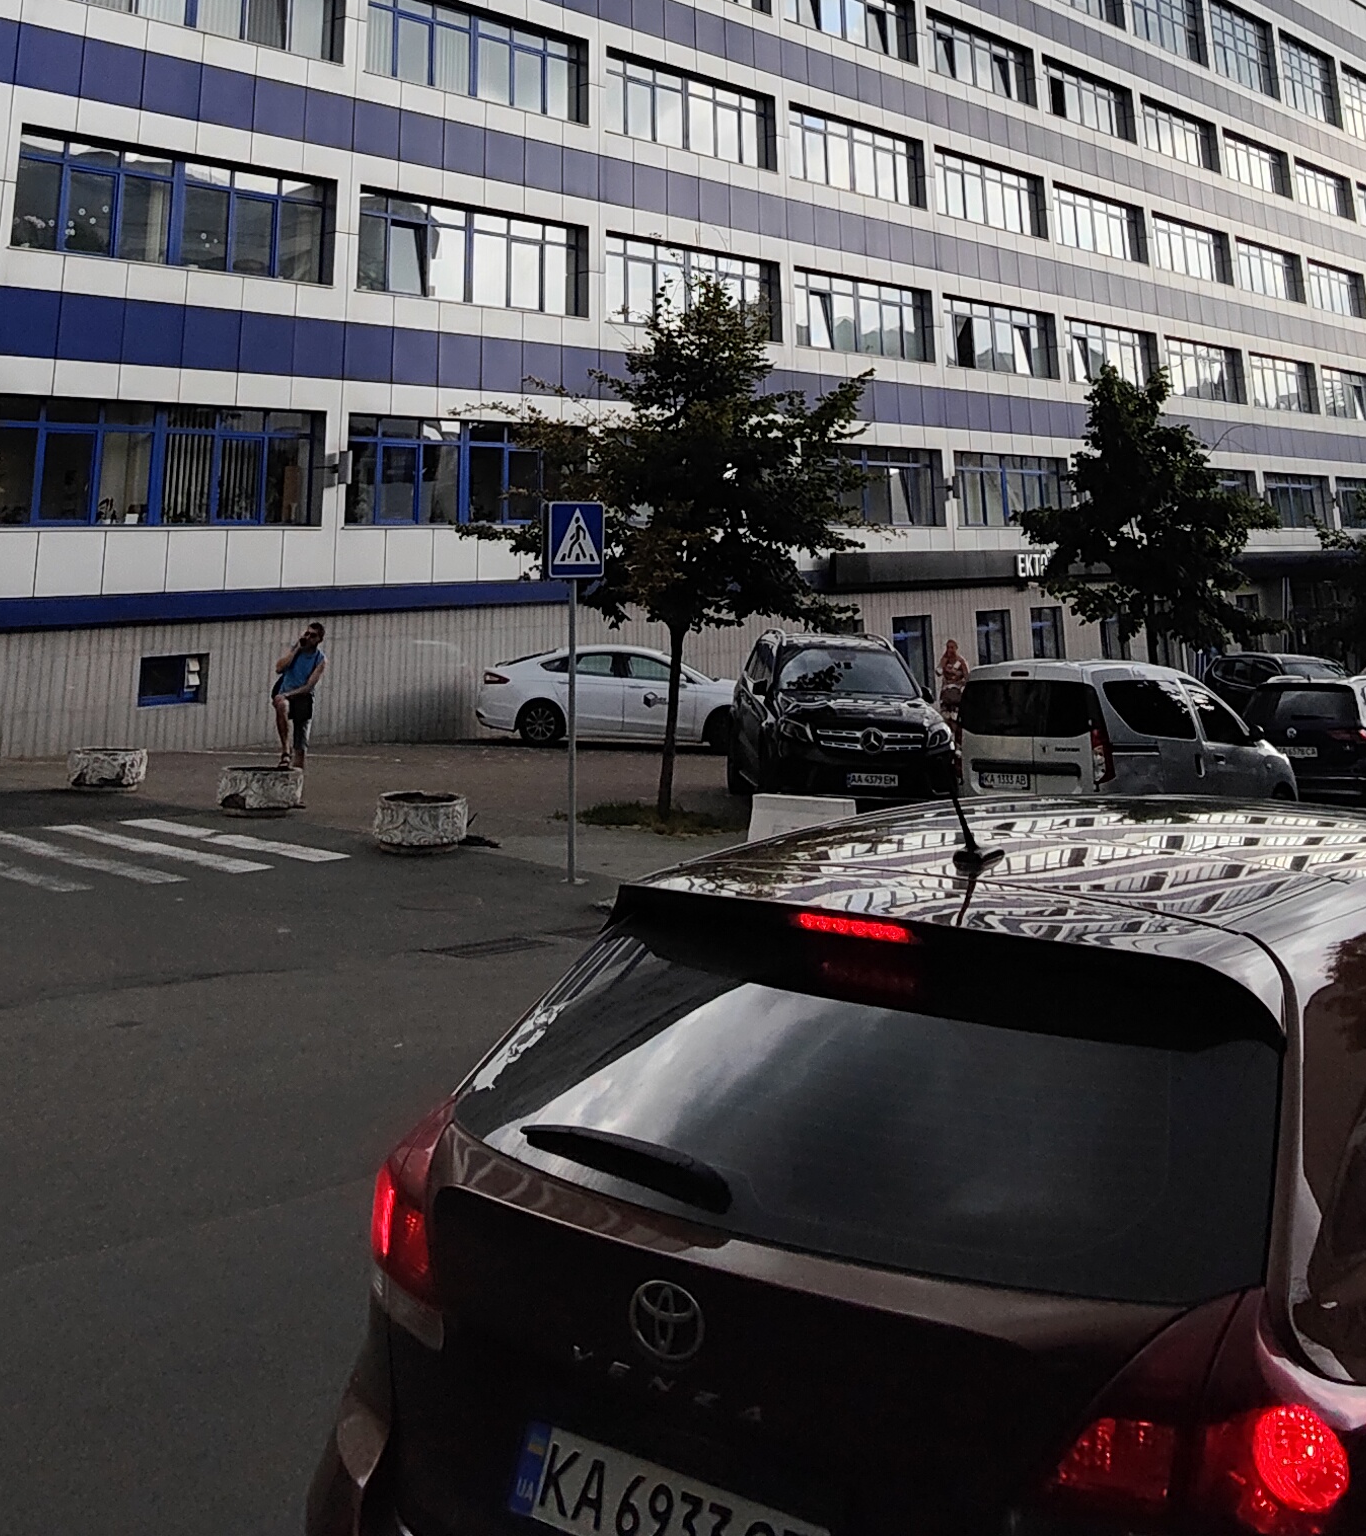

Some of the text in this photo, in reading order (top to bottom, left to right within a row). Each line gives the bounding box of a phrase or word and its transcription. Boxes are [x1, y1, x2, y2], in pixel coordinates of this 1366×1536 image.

[573, 1344, 762, 1423] VENZA
[515, 1477, 534, 1502] UA
[538, 1443, 607, 1532] KA
